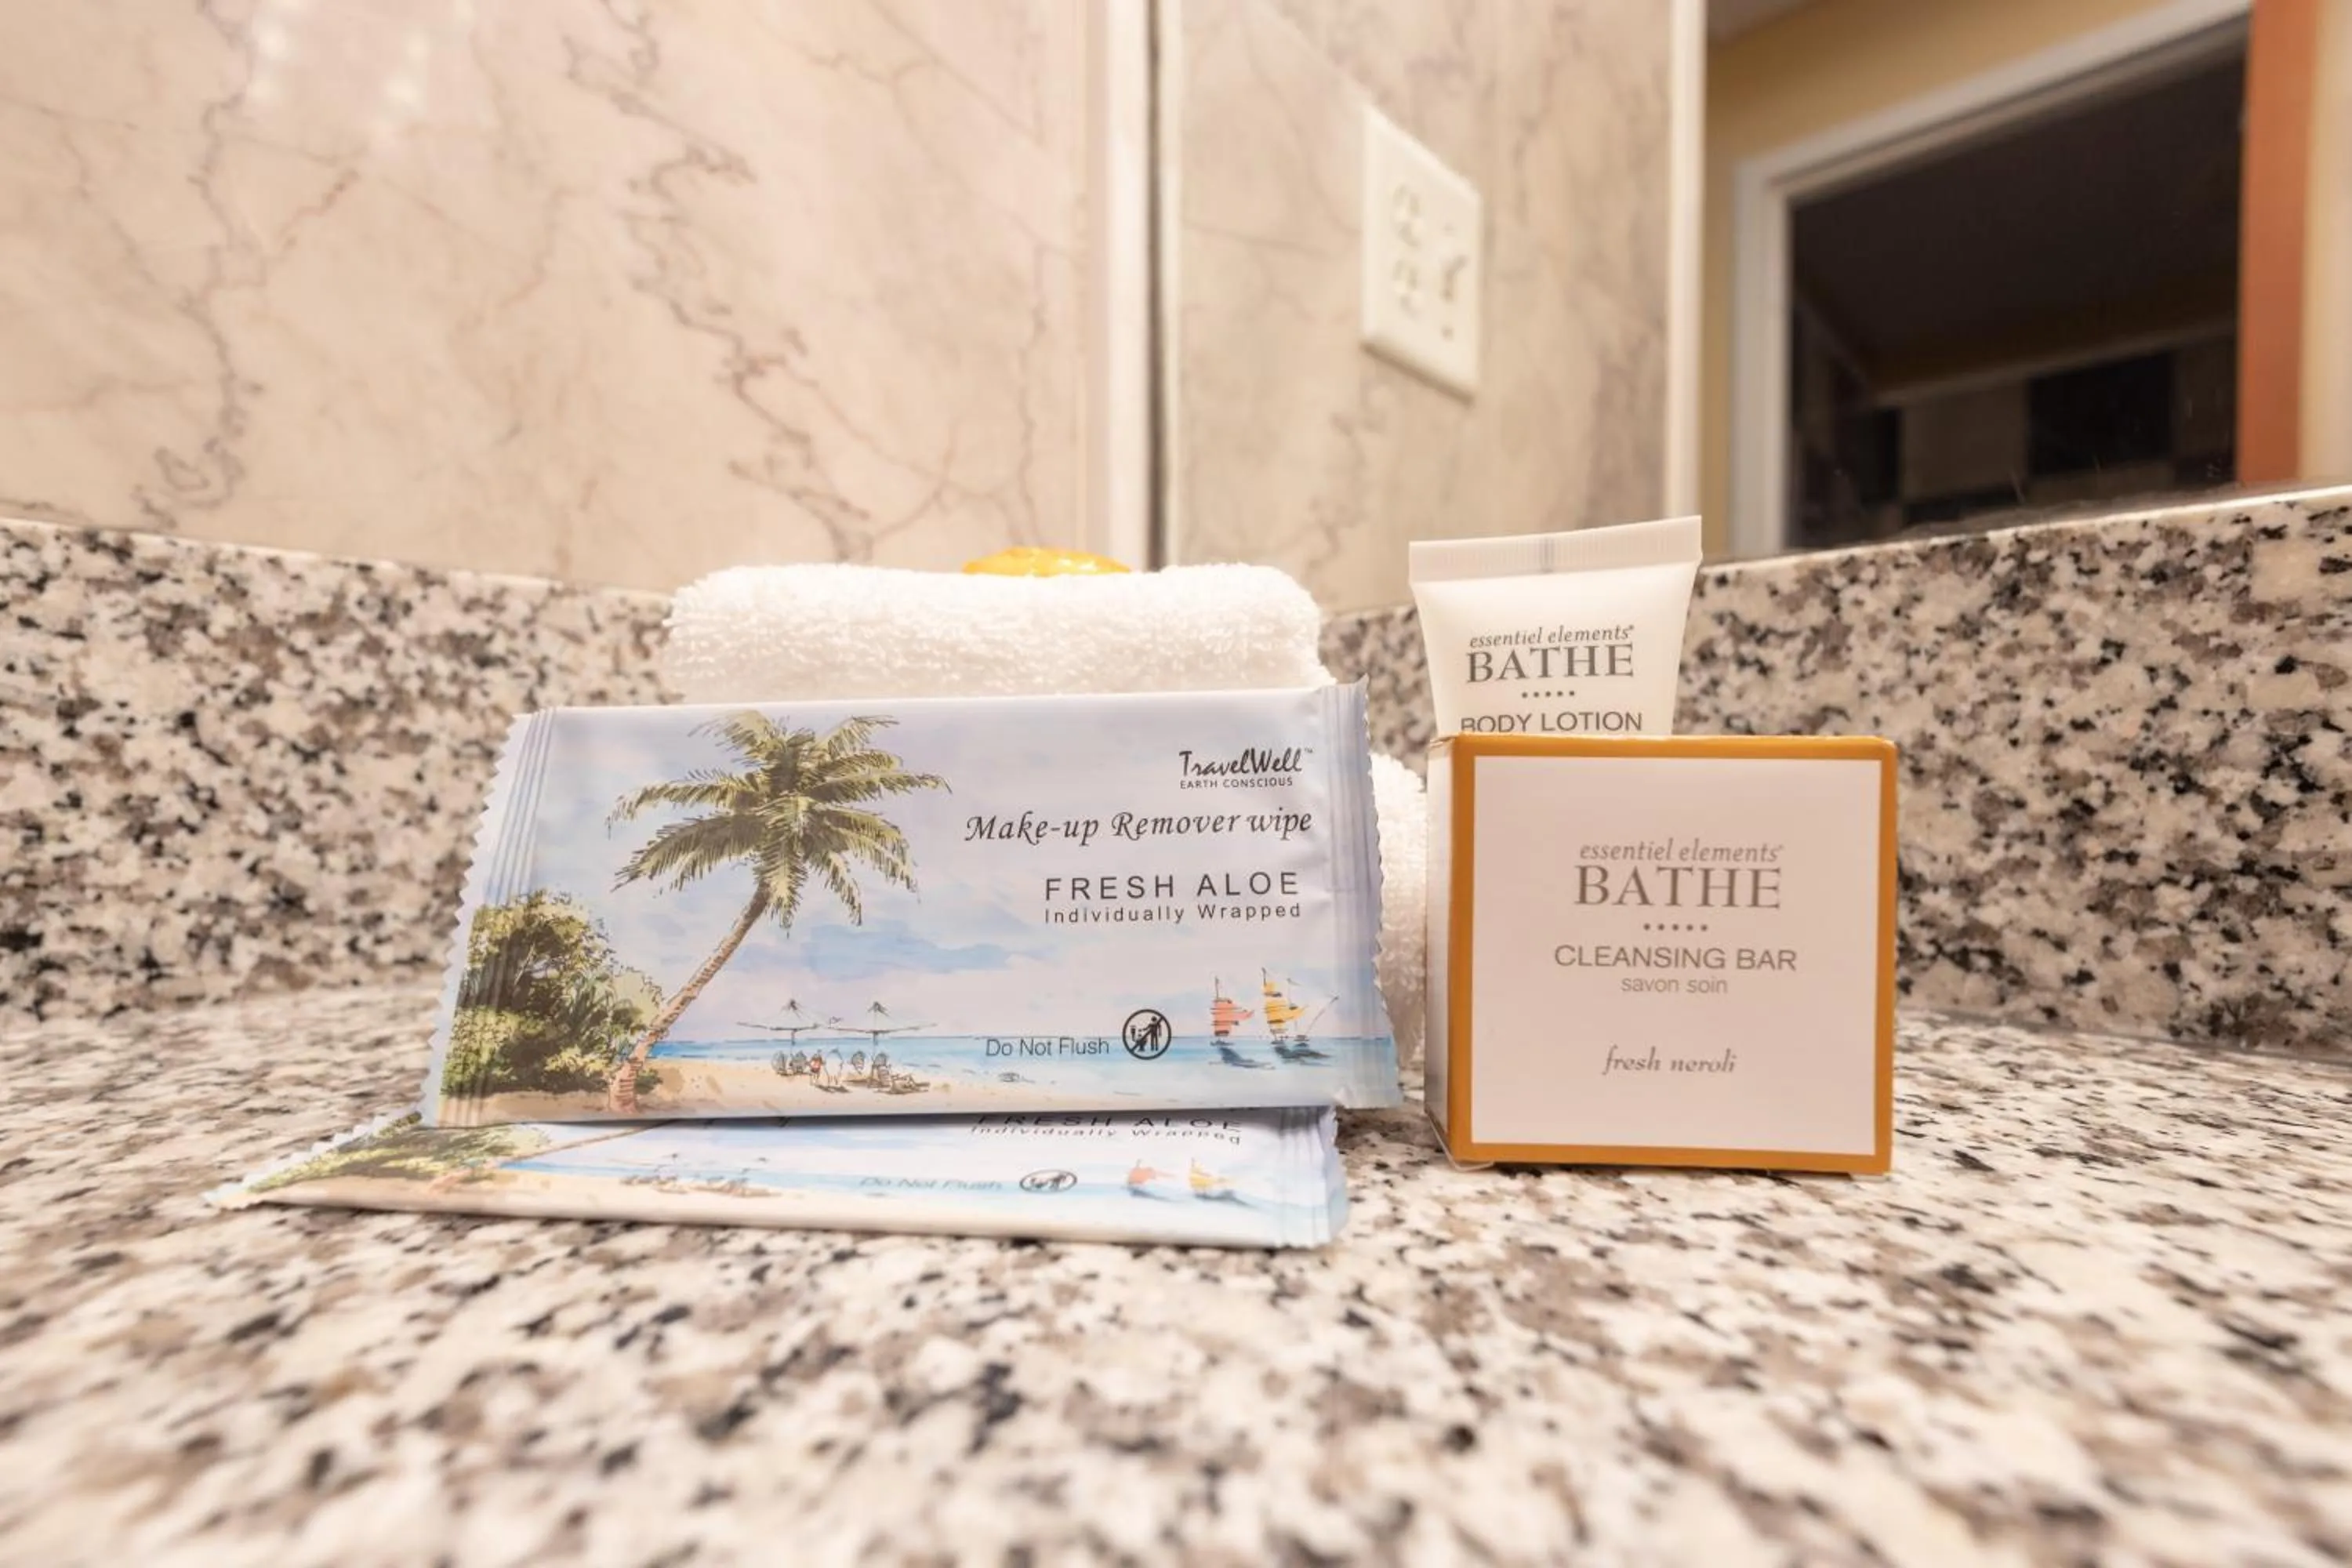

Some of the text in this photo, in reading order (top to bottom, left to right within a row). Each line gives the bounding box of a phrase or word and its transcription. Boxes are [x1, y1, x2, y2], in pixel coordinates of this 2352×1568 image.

[1470, 626, 1543, 648] essentiel
[1465, 643, 1635, 684] BATHE
[1461, 711, 1642, 733] BODY LOTION
[1180, 776, 1293, 789] EARTH CONSCIOUS
[964, 807, 1313, 846] Make-up Remover wipe
[1579, 837, 1674, 861] essentiel
[1045, 871, 1298, 901] FRESH ALOE
[1573, 864, 1781, 909] BATHE
[1045, 902, 1301, 924] Individually Wrapped
[1554, 944, 1798, 971] CLEANSING BAR
[1621, 975, 1728, 994] savon soin
[985, 1036, 1109, 1057] Do Not Flush
[1602, 1044, 1738, 1076] fresh neroli
